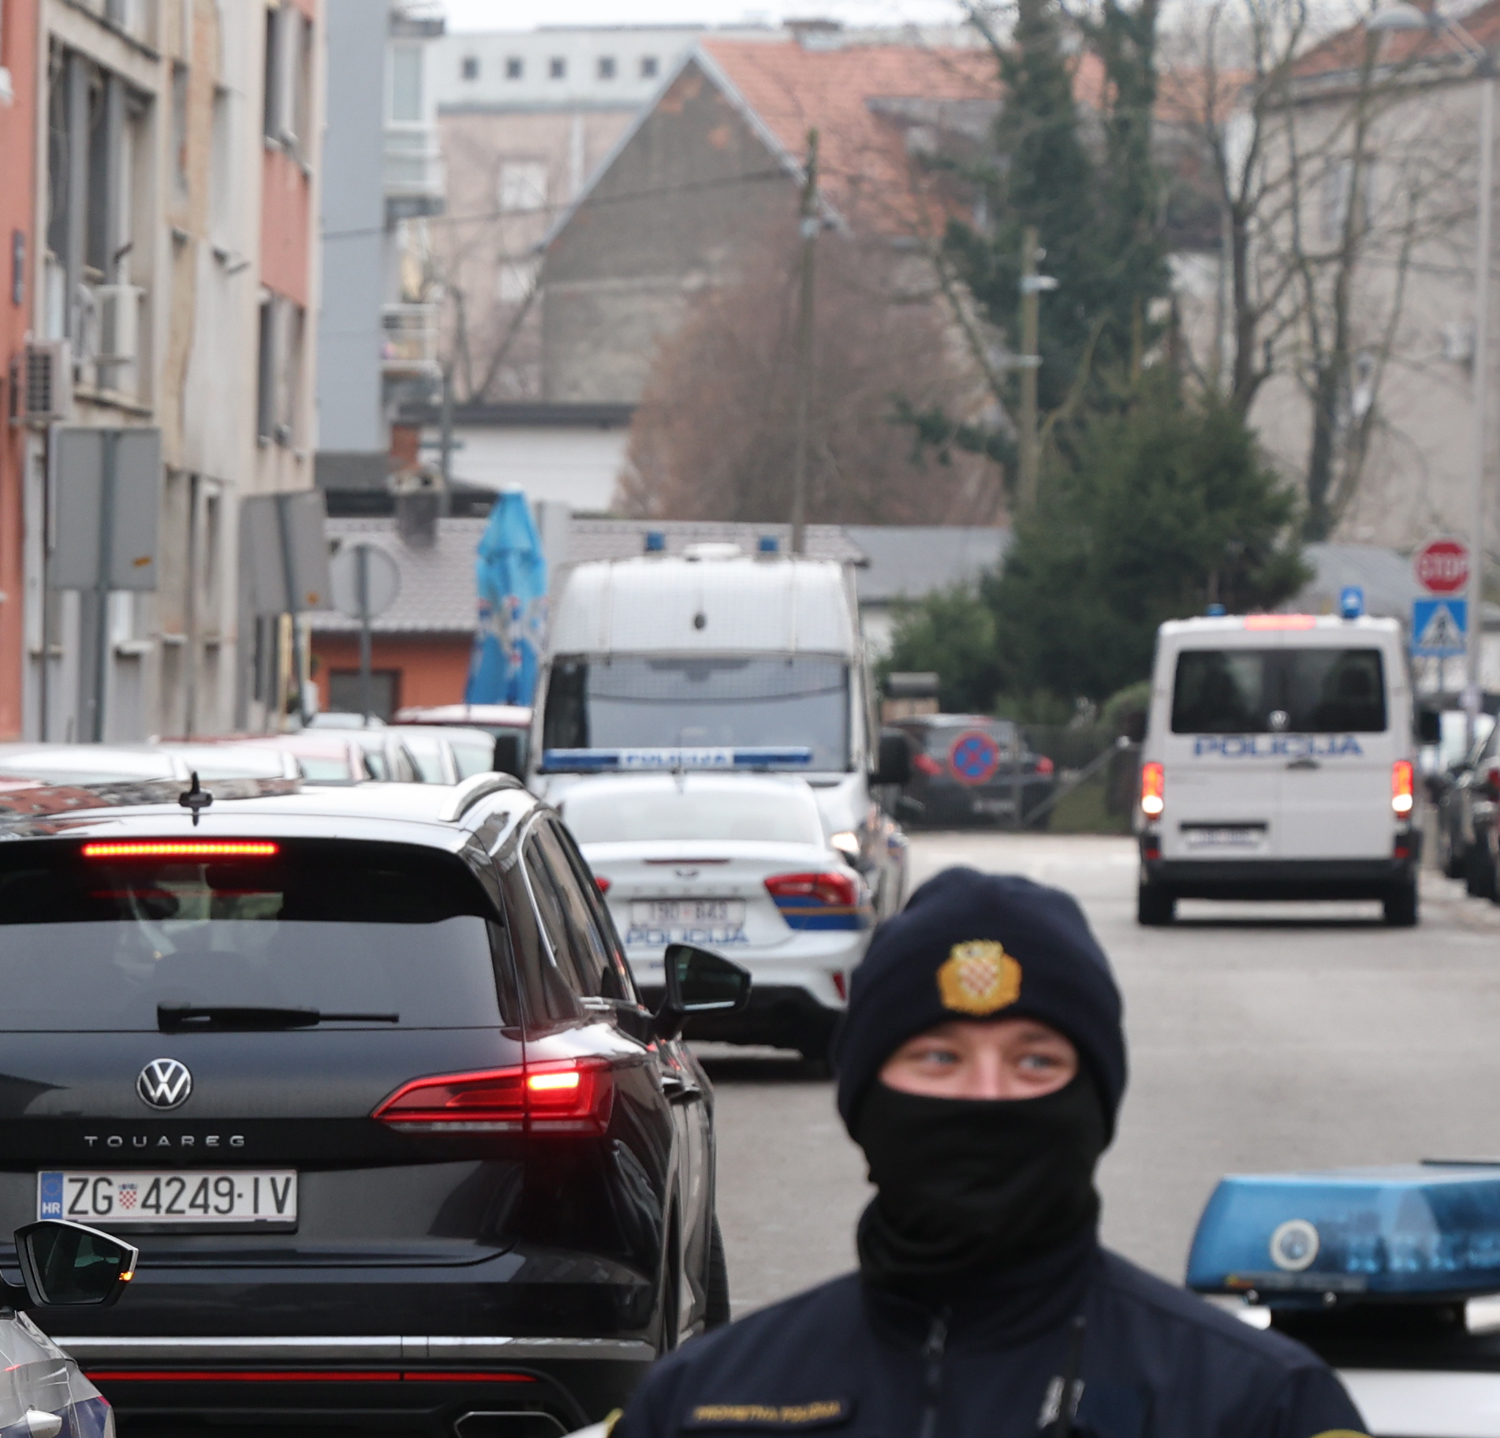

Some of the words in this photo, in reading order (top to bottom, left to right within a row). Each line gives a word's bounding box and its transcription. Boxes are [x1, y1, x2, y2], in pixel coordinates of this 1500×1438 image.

[1420, 556, 1469, 580] STOP
[1194, 734, 1363, 757] POLICIJA
[626, 929, 749, 945] POLICIJA
[84, 1135, 245, 1147] TOUAREG
[68, 1177, 114, 1215] ZG
[42, 1202, 61, 1215] HR
